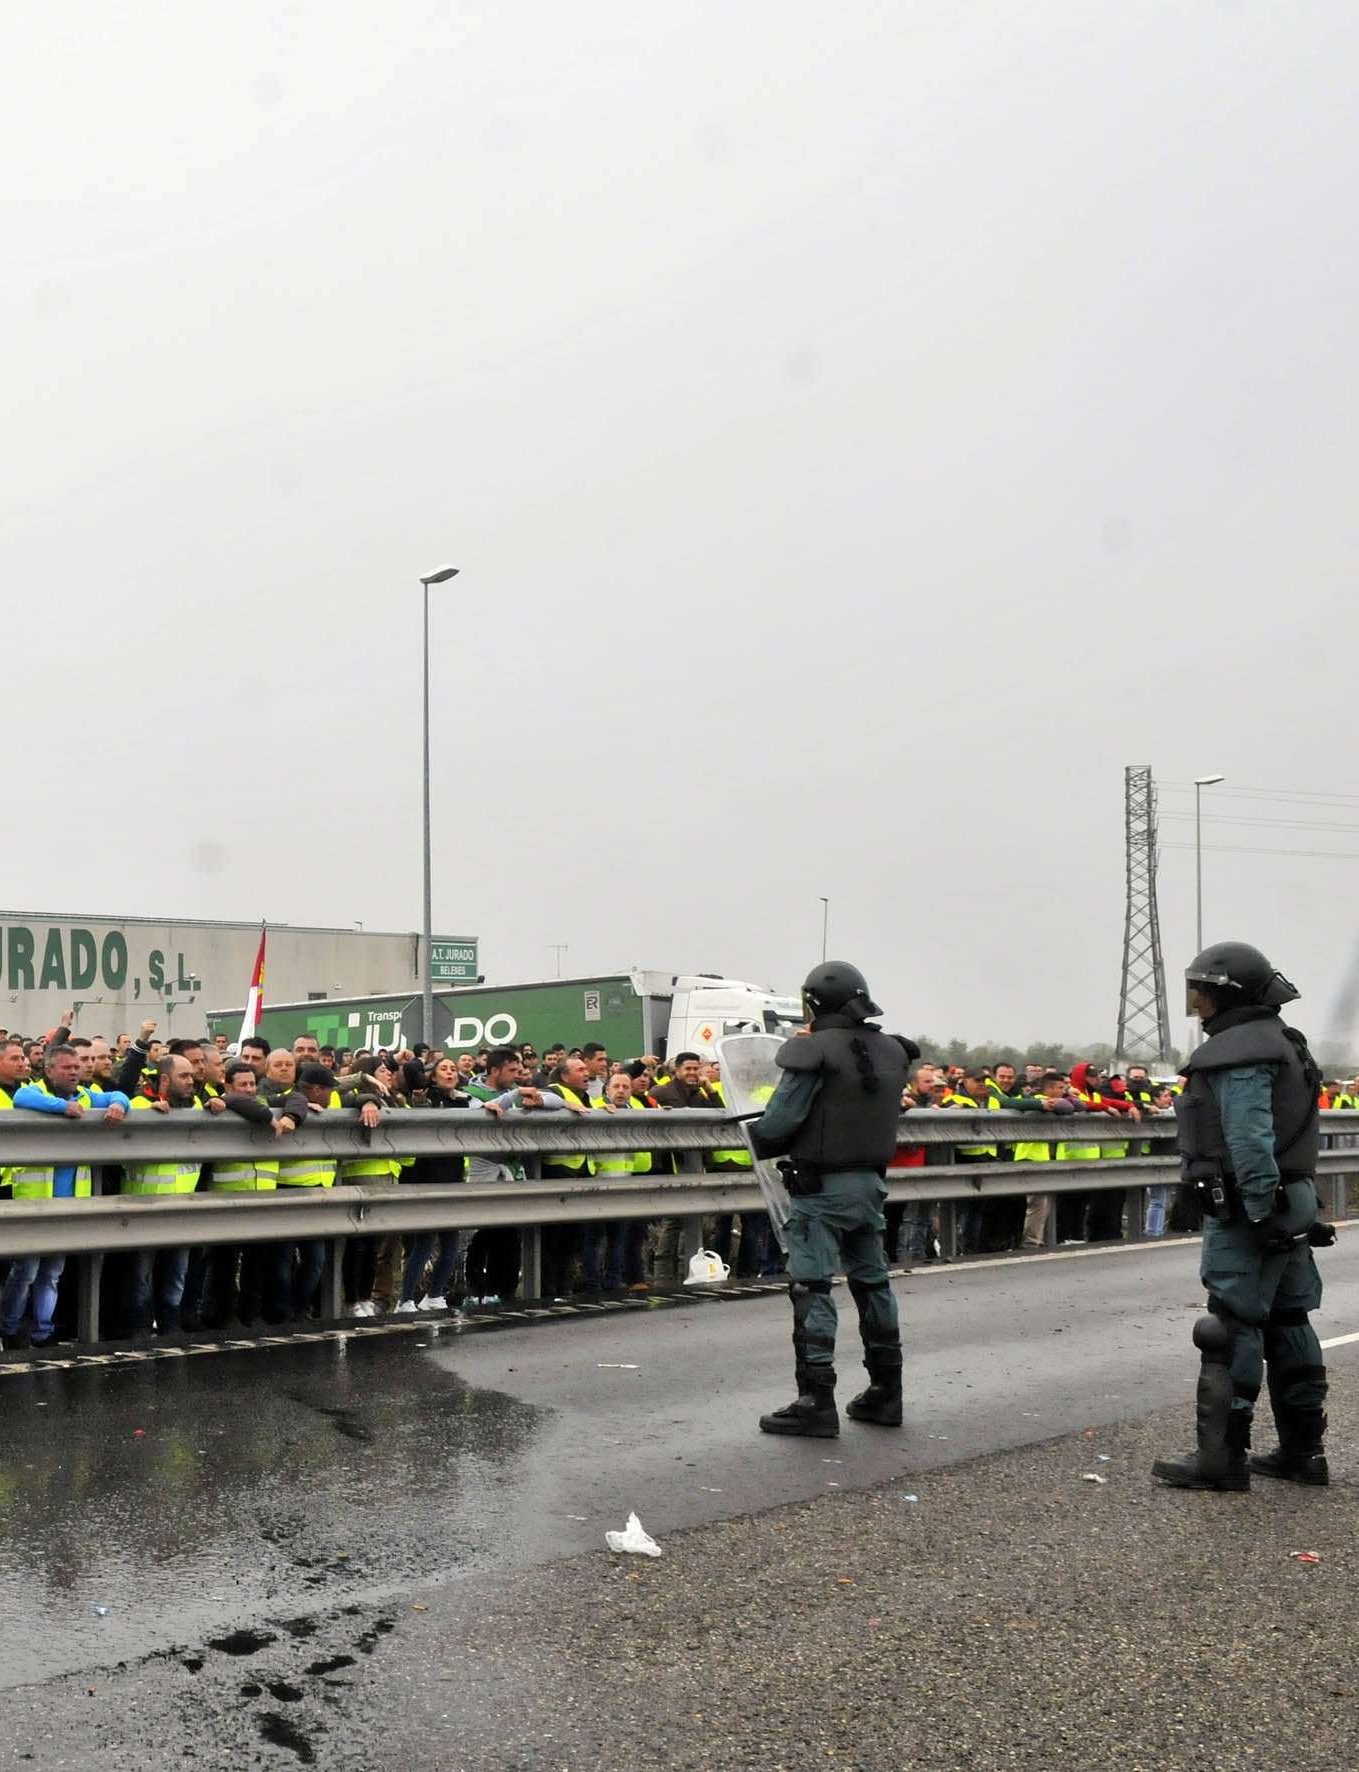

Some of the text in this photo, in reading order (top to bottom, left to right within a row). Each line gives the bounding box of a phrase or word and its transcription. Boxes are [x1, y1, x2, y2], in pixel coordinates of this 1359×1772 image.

[445, 948, 474, 961] JURADO
[440, 965, 466, 976] BELENES
[367, 1010, 403, 1023] Transp
[354, 1013, 517, 1056] JUDO
